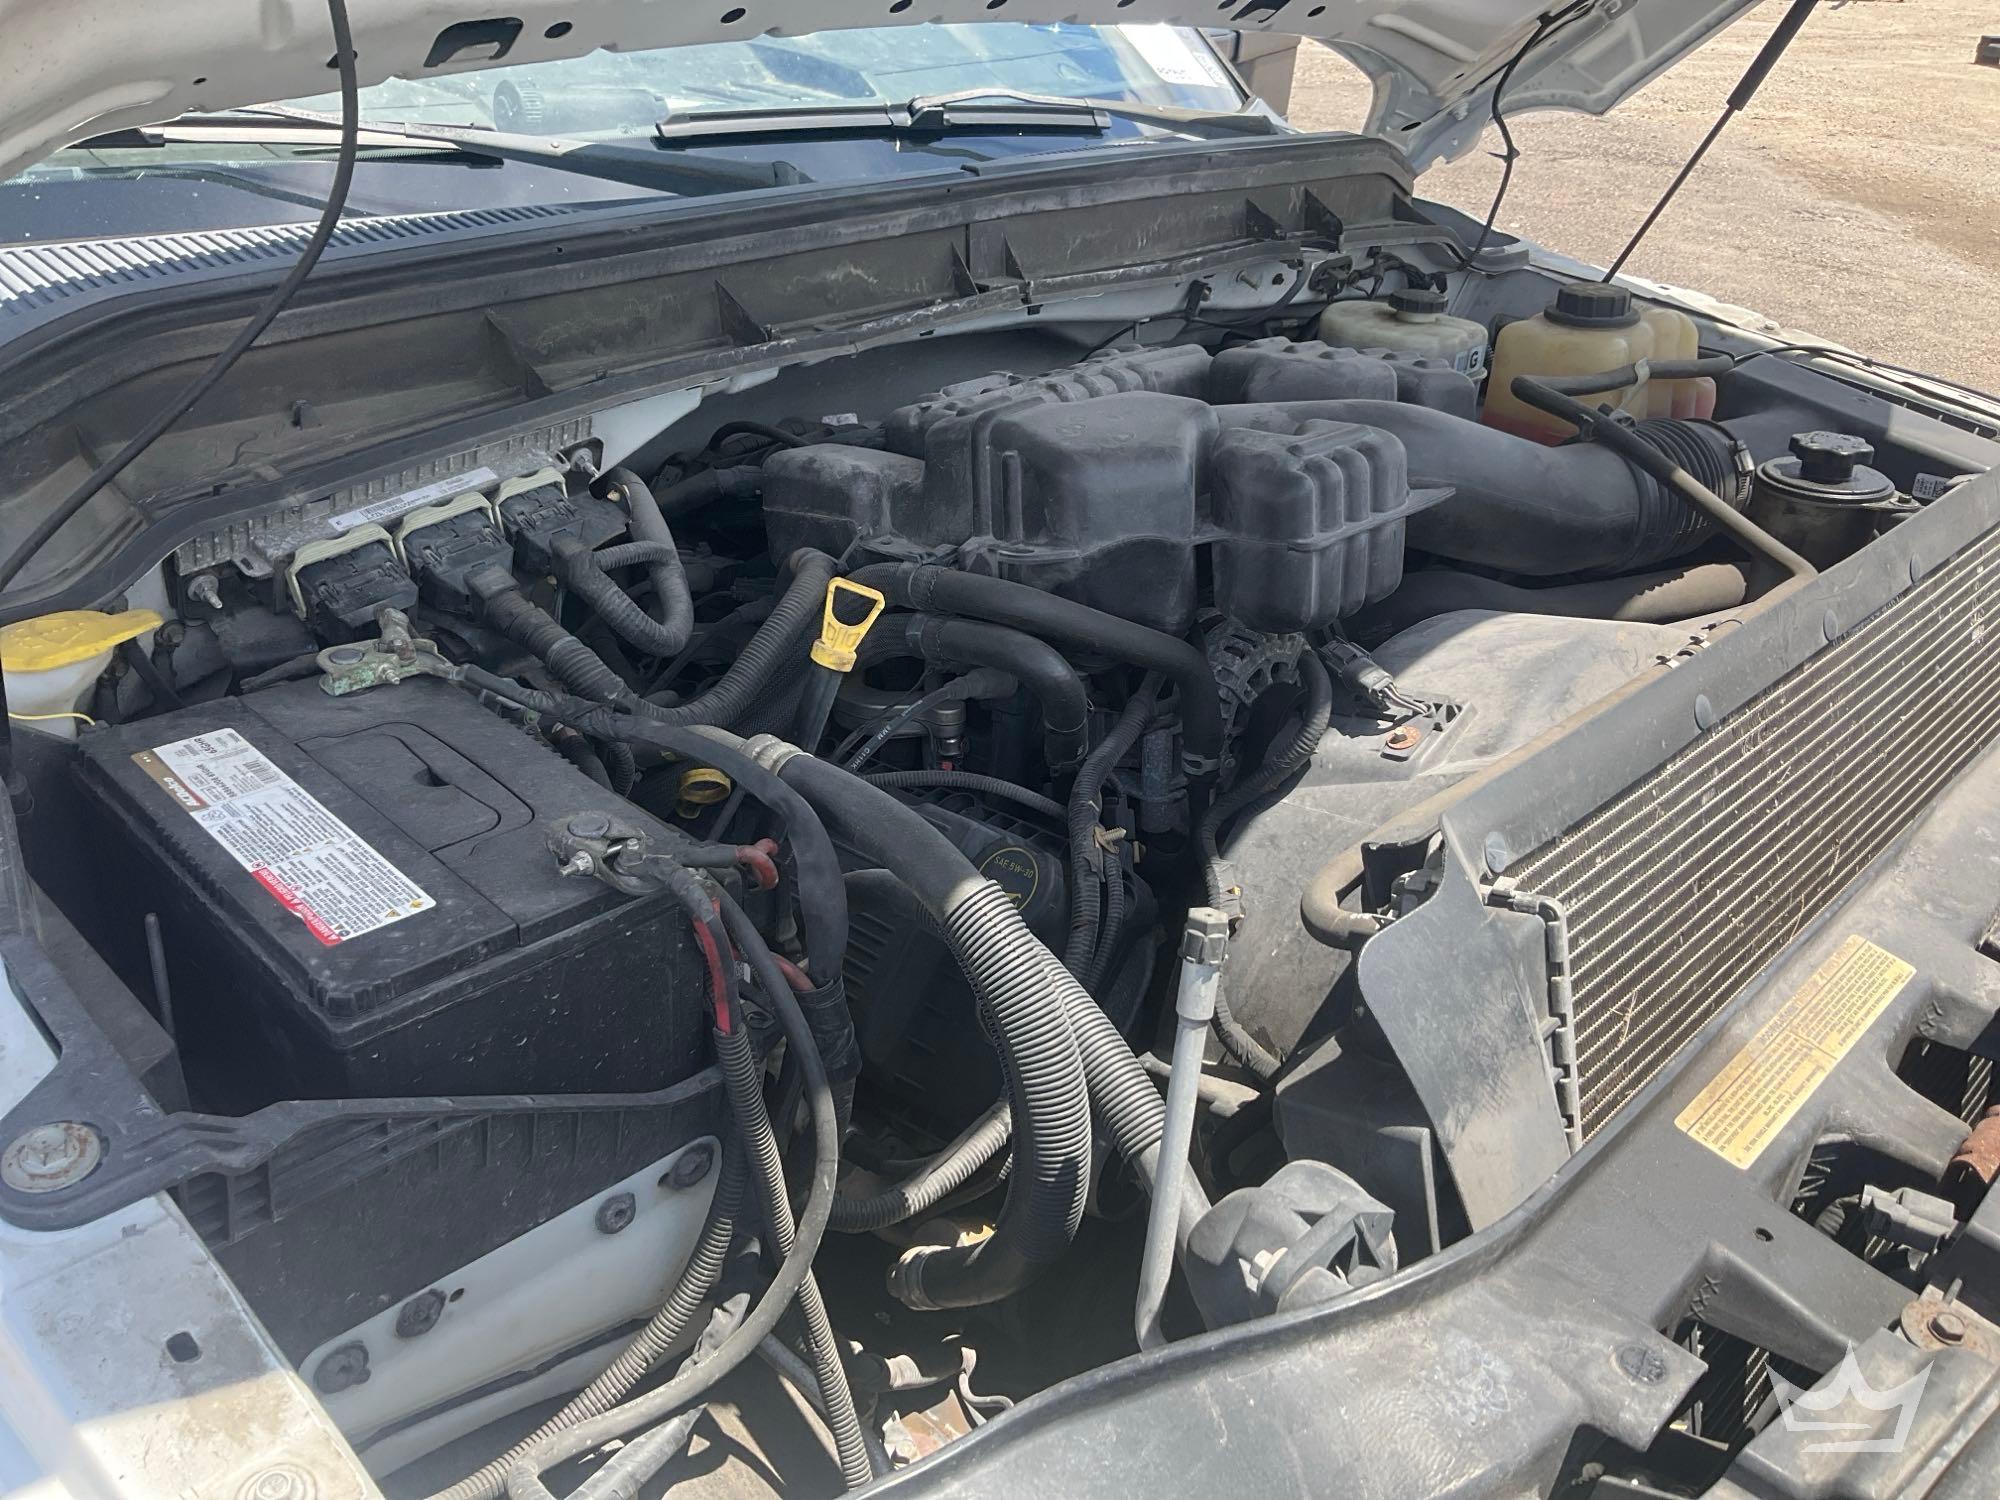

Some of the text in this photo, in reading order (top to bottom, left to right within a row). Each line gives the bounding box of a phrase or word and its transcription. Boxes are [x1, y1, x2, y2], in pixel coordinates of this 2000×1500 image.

[1470, 350, 1479, 368] G
[163, 777, 201, 806] ACDelco
[994, 856, 1009, 868] SAE
